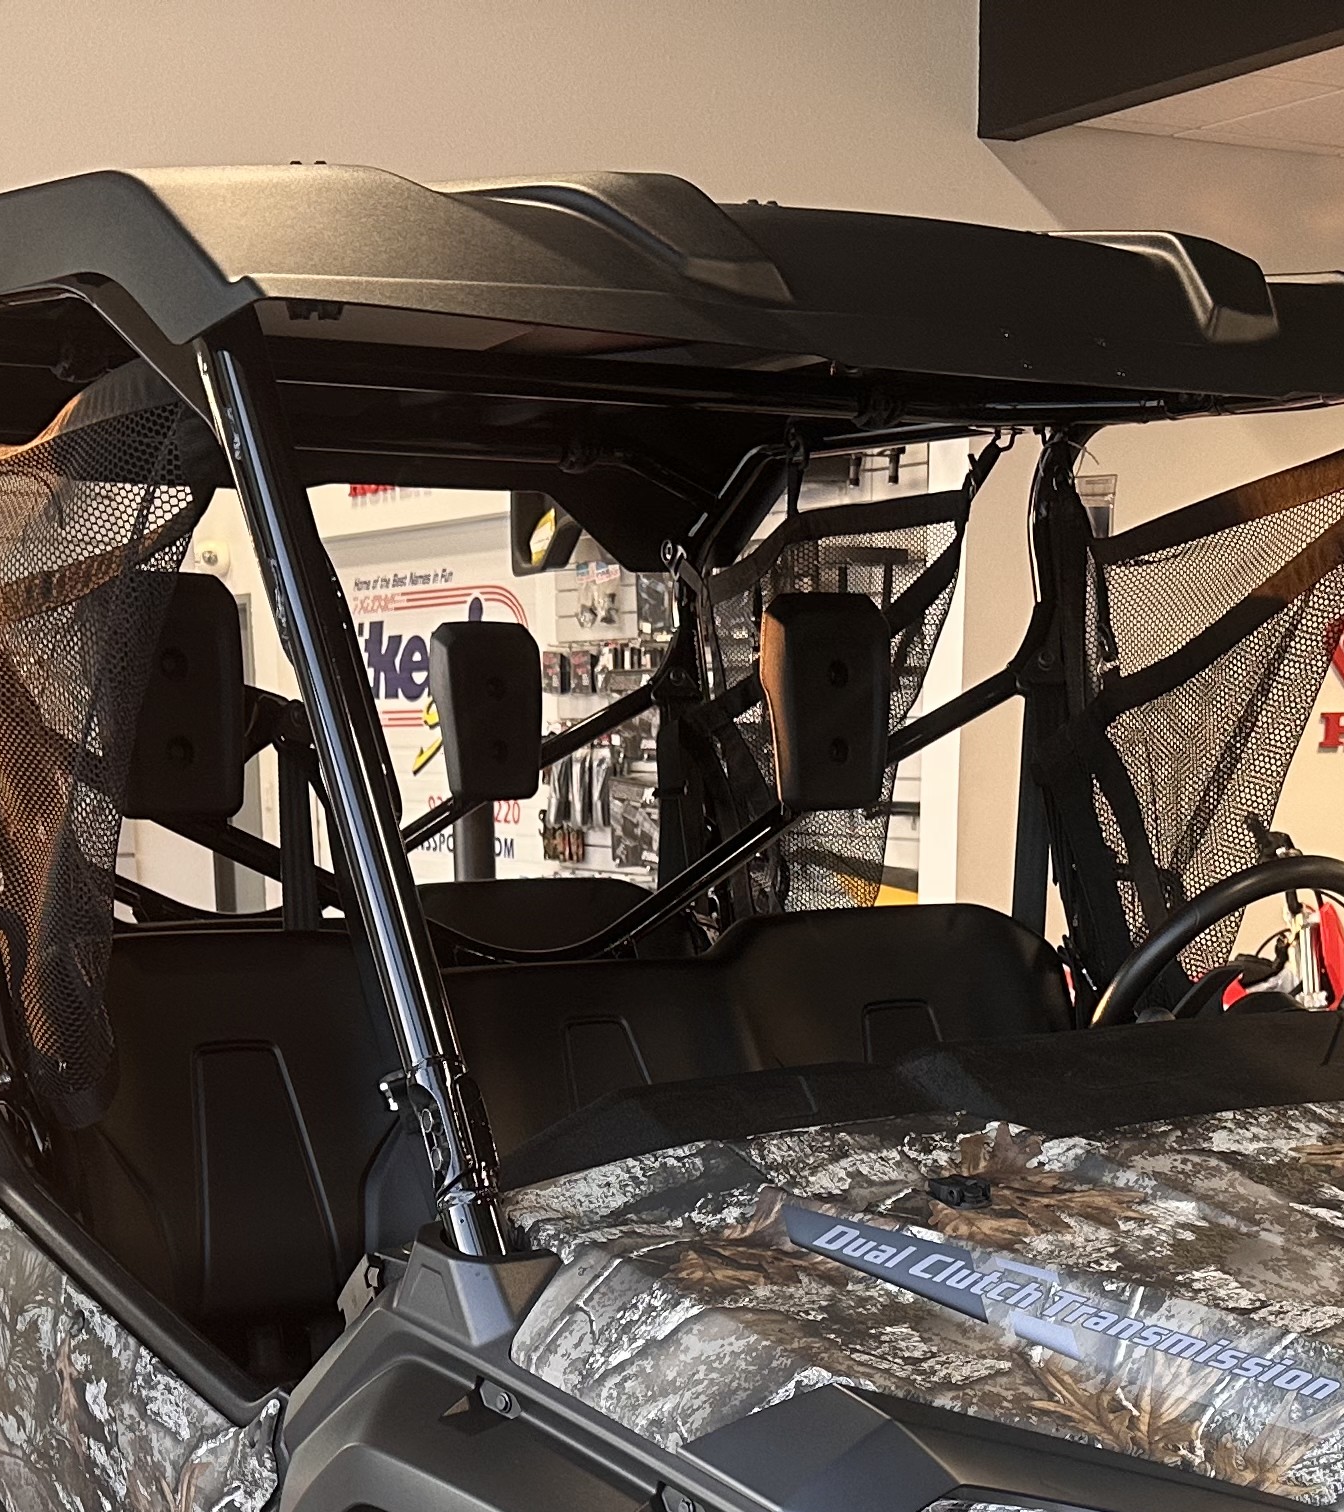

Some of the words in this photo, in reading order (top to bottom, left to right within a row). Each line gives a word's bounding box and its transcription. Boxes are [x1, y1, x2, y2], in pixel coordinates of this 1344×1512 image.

[353, 577, 371, 592] Home
[371, 575, 380, 591] of
[380, 574, 390, 590] the
[391, 572, 407, 589] Best
[408, 570, 431, 587] Names
[432, 570, 440, 585] in
[440, 567, 454, 584] Fun
[812, 1224, 918, 1269] Dual
[908, 1252, 1045, 1310] Clutch
[1043, 1289, 1342, 1400] Transmission
